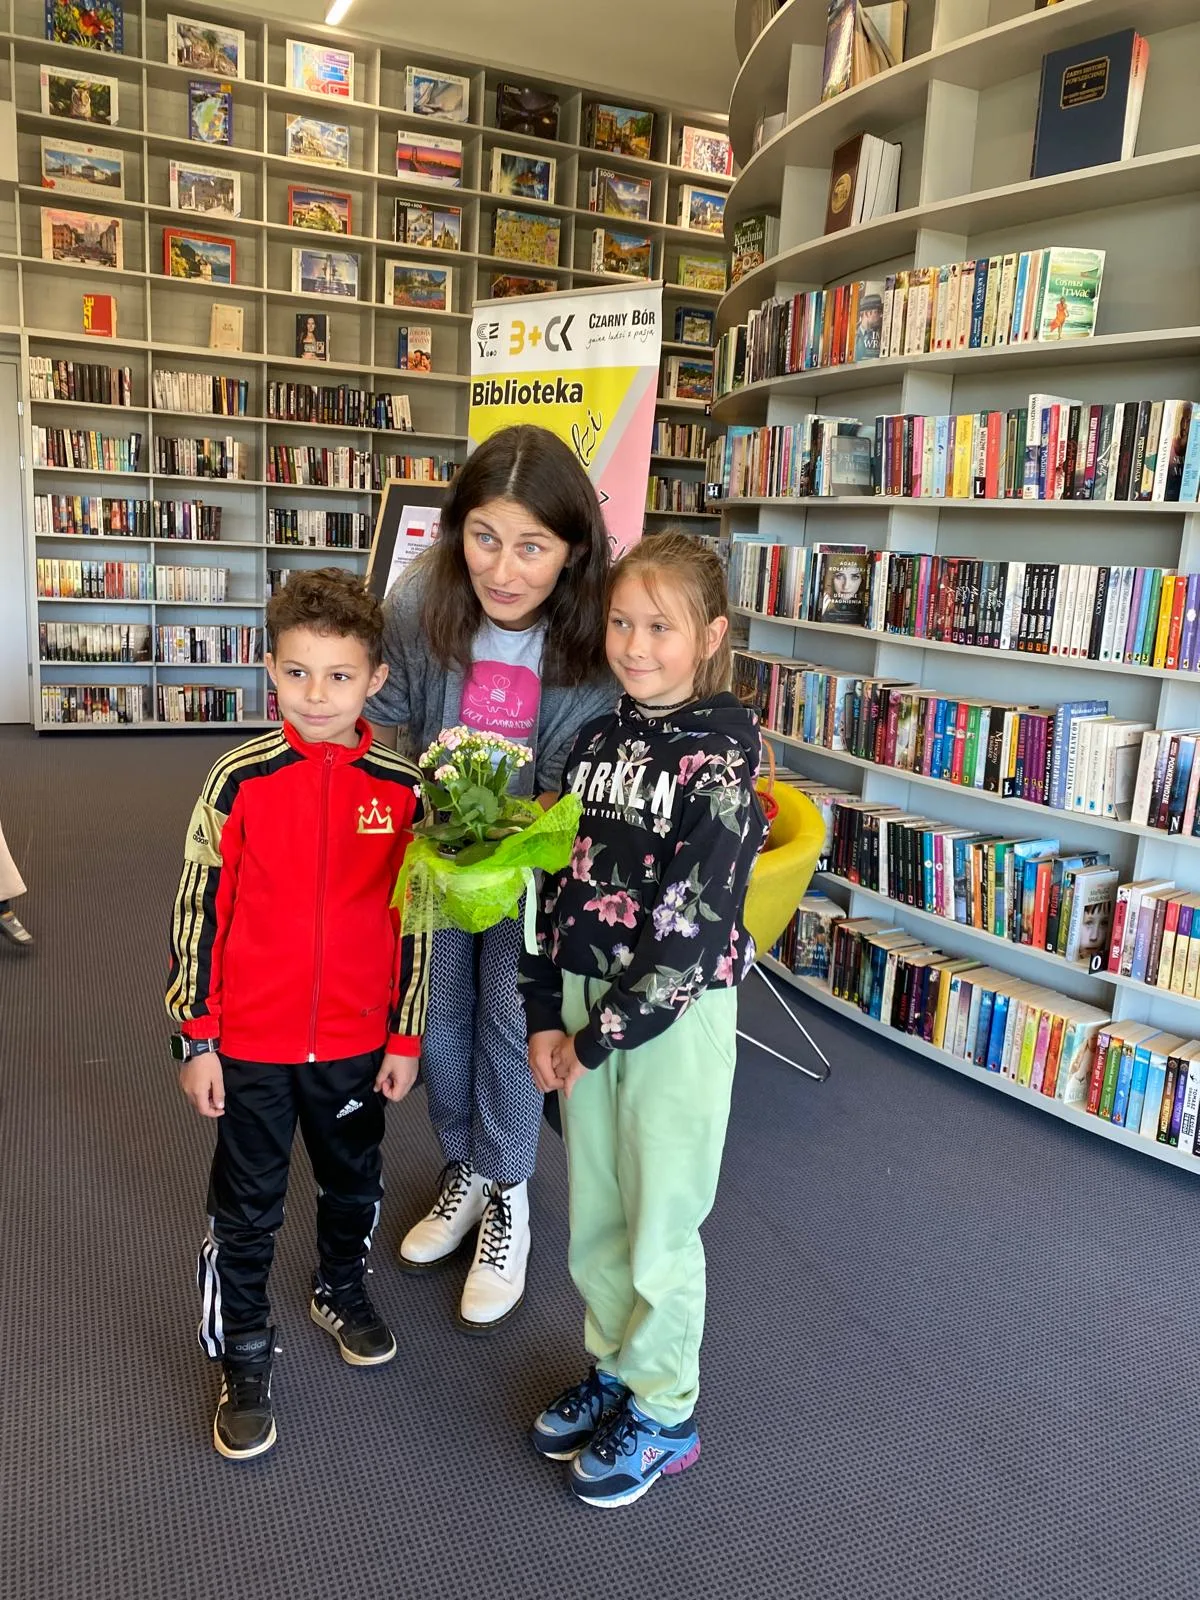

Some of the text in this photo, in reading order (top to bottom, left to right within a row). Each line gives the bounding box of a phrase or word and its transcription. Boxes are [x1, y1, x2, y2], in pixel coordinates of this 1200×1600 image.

[734, 230, 763, 247] Kuchnia
[588, 309, 656, 330] CZARNY BÓR
[472, 376, 584, 407] Biblioteka
[707, 486, 719, 496] H
[975, 480, 985, 495] L
[1162, 756, 1175, 805] PODKRZYWDZIE
[570, 761, 679, 820] BRKLN
[600, 811, 622, 821] YORK
[624, 813, 644, 825] CITY
[1170, 815, 1181, 832] N
[815, 859, 828, 872] M
[1190, 1088, 1198, 1110] TOMASZ
[235, 1339, 267, 1351] adidas
